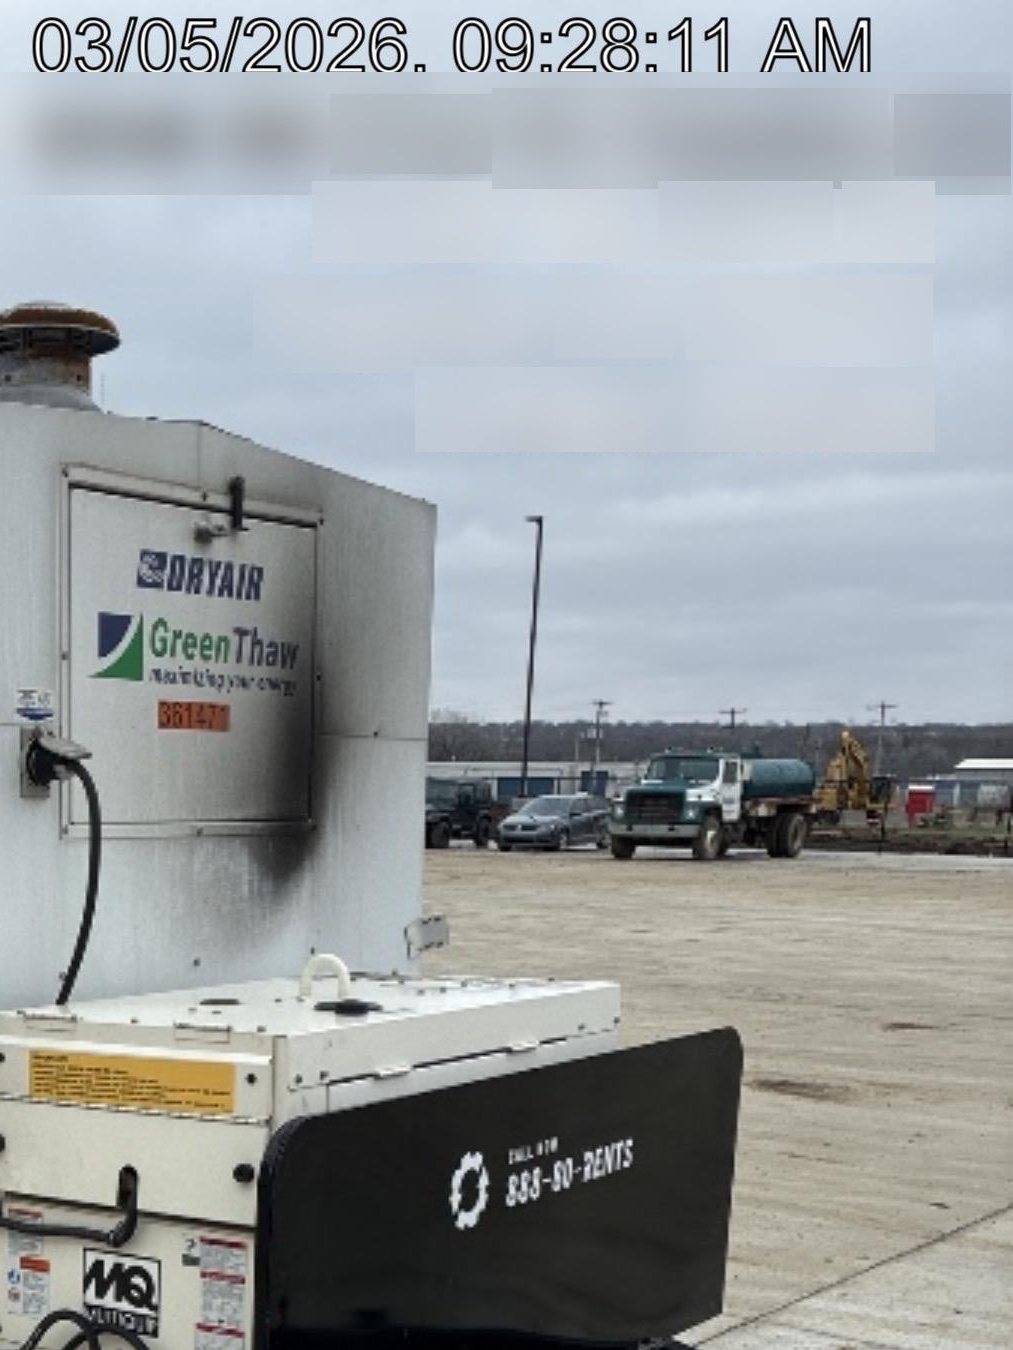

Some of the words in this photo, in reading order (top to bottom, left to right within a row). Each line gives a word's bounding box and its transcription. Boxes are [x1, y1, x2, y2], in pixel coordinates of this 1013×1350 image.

[166, 554, 264, 601] DRYAIR
[149, 617, 300, 670] GreenThaw
[84, 1258, 158, 1312] MQ
